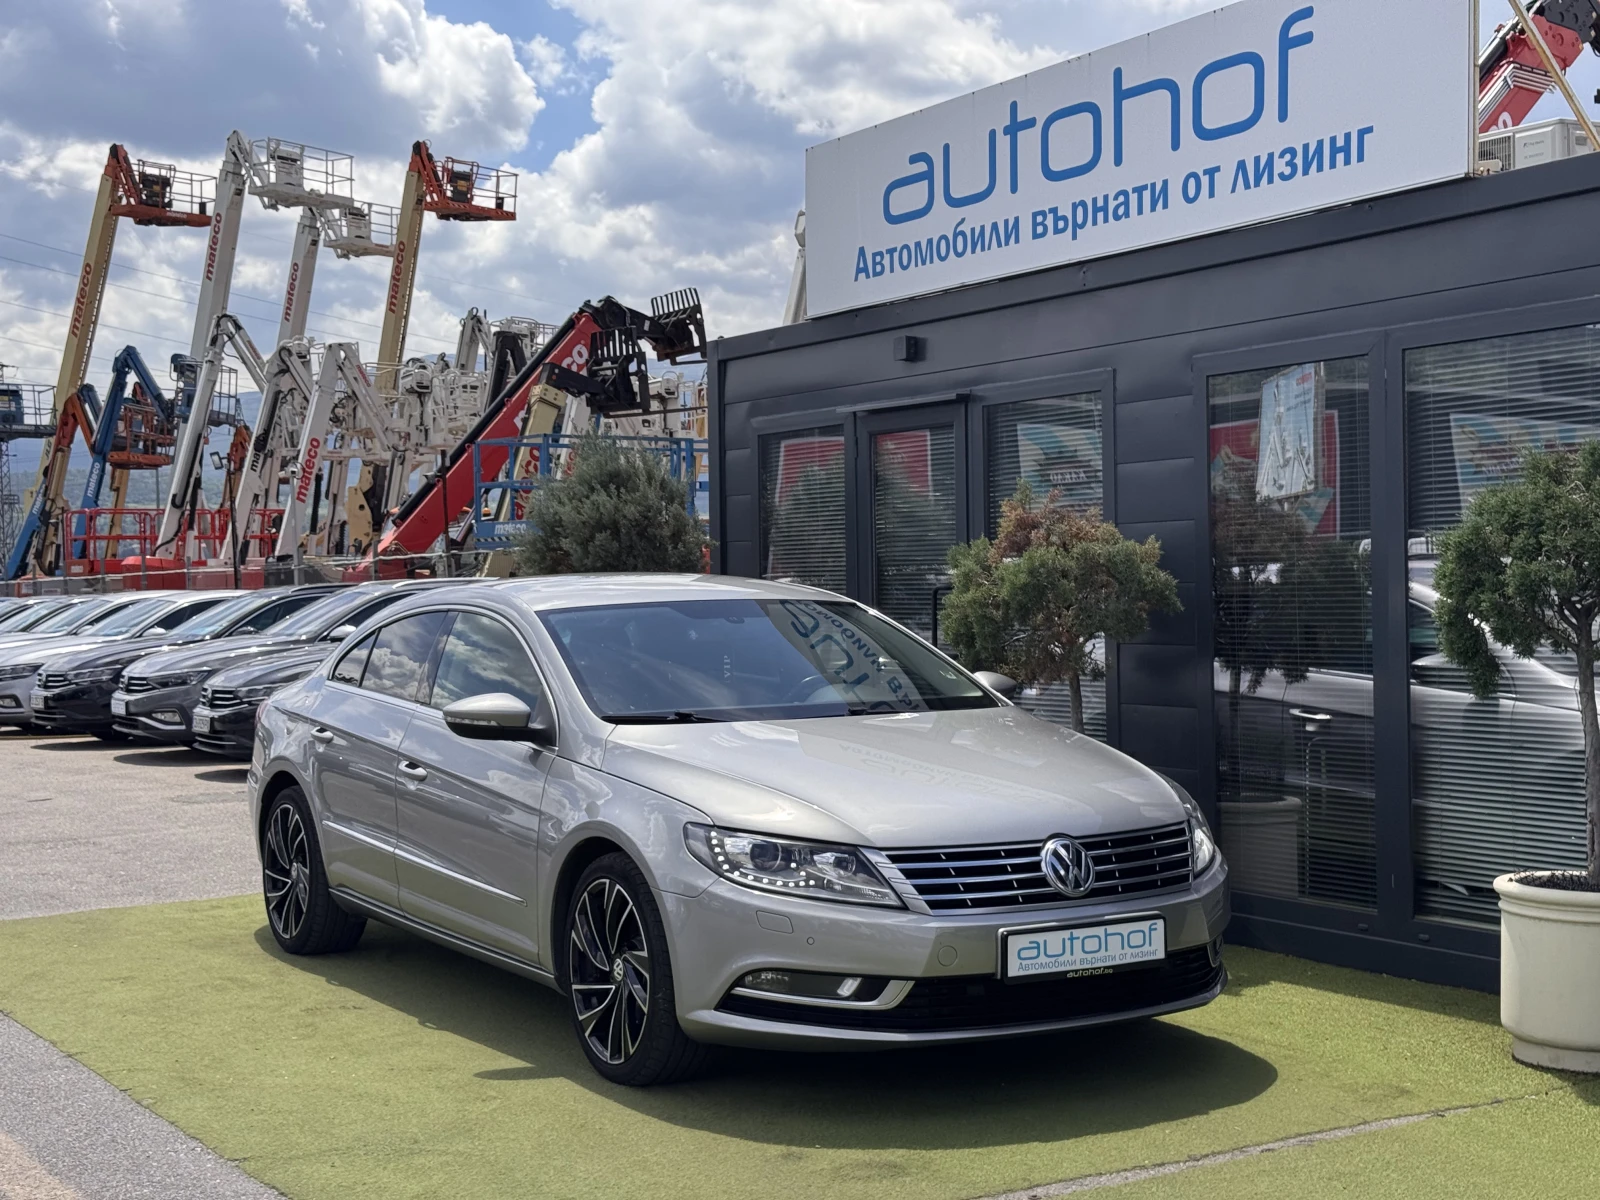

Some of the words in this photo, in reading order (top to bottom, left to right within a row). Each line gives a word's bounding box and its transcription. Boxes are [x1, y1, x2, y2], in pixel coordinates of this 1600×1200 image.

[883, 5, 1314, 225] autohof
[854, 216, 1020, 282] Автомобили
[1031, 178, 1169, 241] върнати
[1181, 165, 1221, 204] от
[1230, 125, 1374, 194] лизинг
[205, 211, 223, 282] mateco
[388, 240, 406, 314] mateco
[71, 262, 92, 339] mateco
[284, 262, 300, 323] mateco
[87, 462, 101, 498] mateco
[296, 437, 321, 504] mateco
[1017, 921, 1158, 961] autohof
[1017, 958, 1077, 972] Автомобили
[1079, 954, 1117, 966] върнати
[1118, 952, 1128, 961] от
[1129, 949, 1158, 959] лизинг
[1066, 967, 1114, 978] autohof.bg
